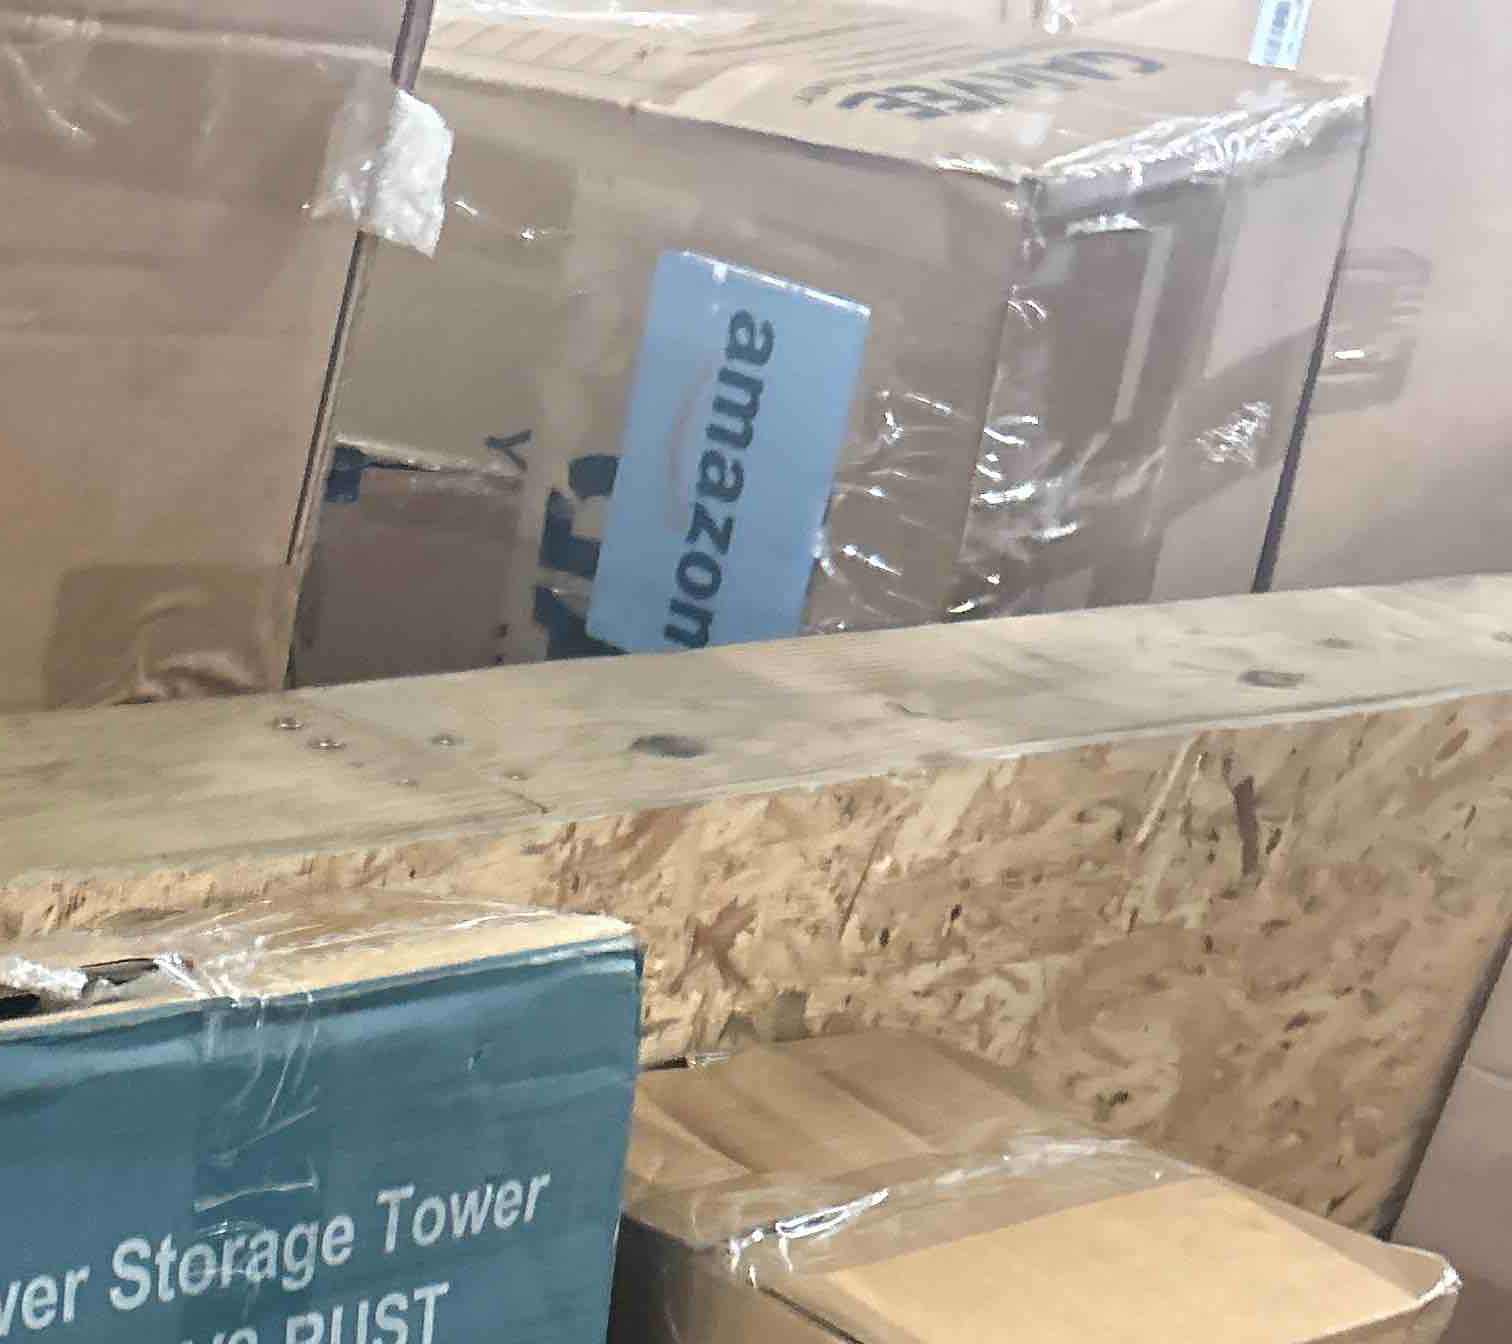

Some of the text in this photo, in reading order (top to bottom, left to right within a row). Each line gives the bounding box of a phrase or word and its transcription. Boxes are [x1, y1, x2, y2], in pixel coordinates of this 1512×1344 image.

[663, 308, 776, 650] amazon
[109, 1211, 354, 1313] Storage
[377, 1172, 552, 1257] Tower
